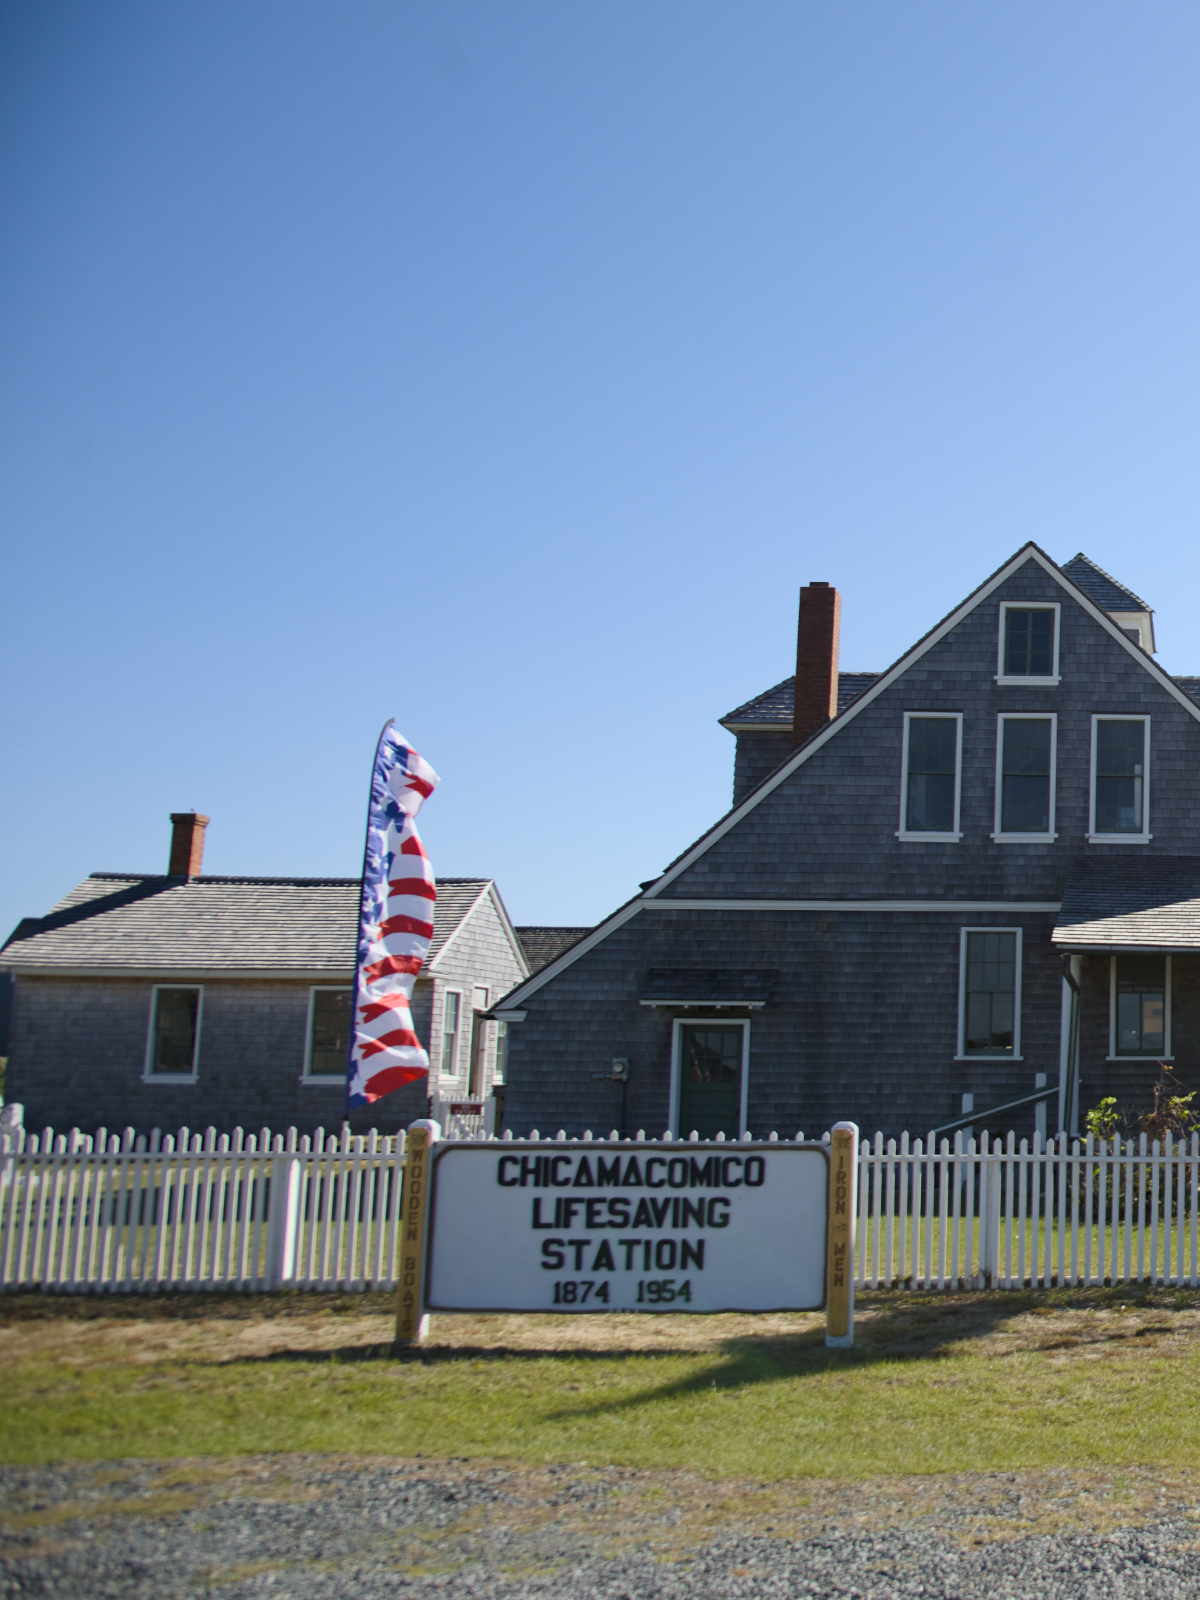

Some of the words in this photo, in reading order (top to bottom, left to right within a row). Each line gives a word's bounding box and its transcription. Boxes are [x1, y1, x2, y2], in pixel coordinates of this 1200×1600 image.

[497, 1155, 766, 1188] CHICAMACOMICO
[835, 1155, 846, 1215] IRON
[408, 1149, 424, 1241] WOODEN
[532, 1197, 731, 1229] LIFESAVING
[541, 1238, 705, 1271] STATION
[834, 1242, 845, 1287] MEN
[403, 1257, 416, 1332] BOATS
[553, 1280, 610, 1304] 1874
[636, 1279, 692, 1303] 1954
